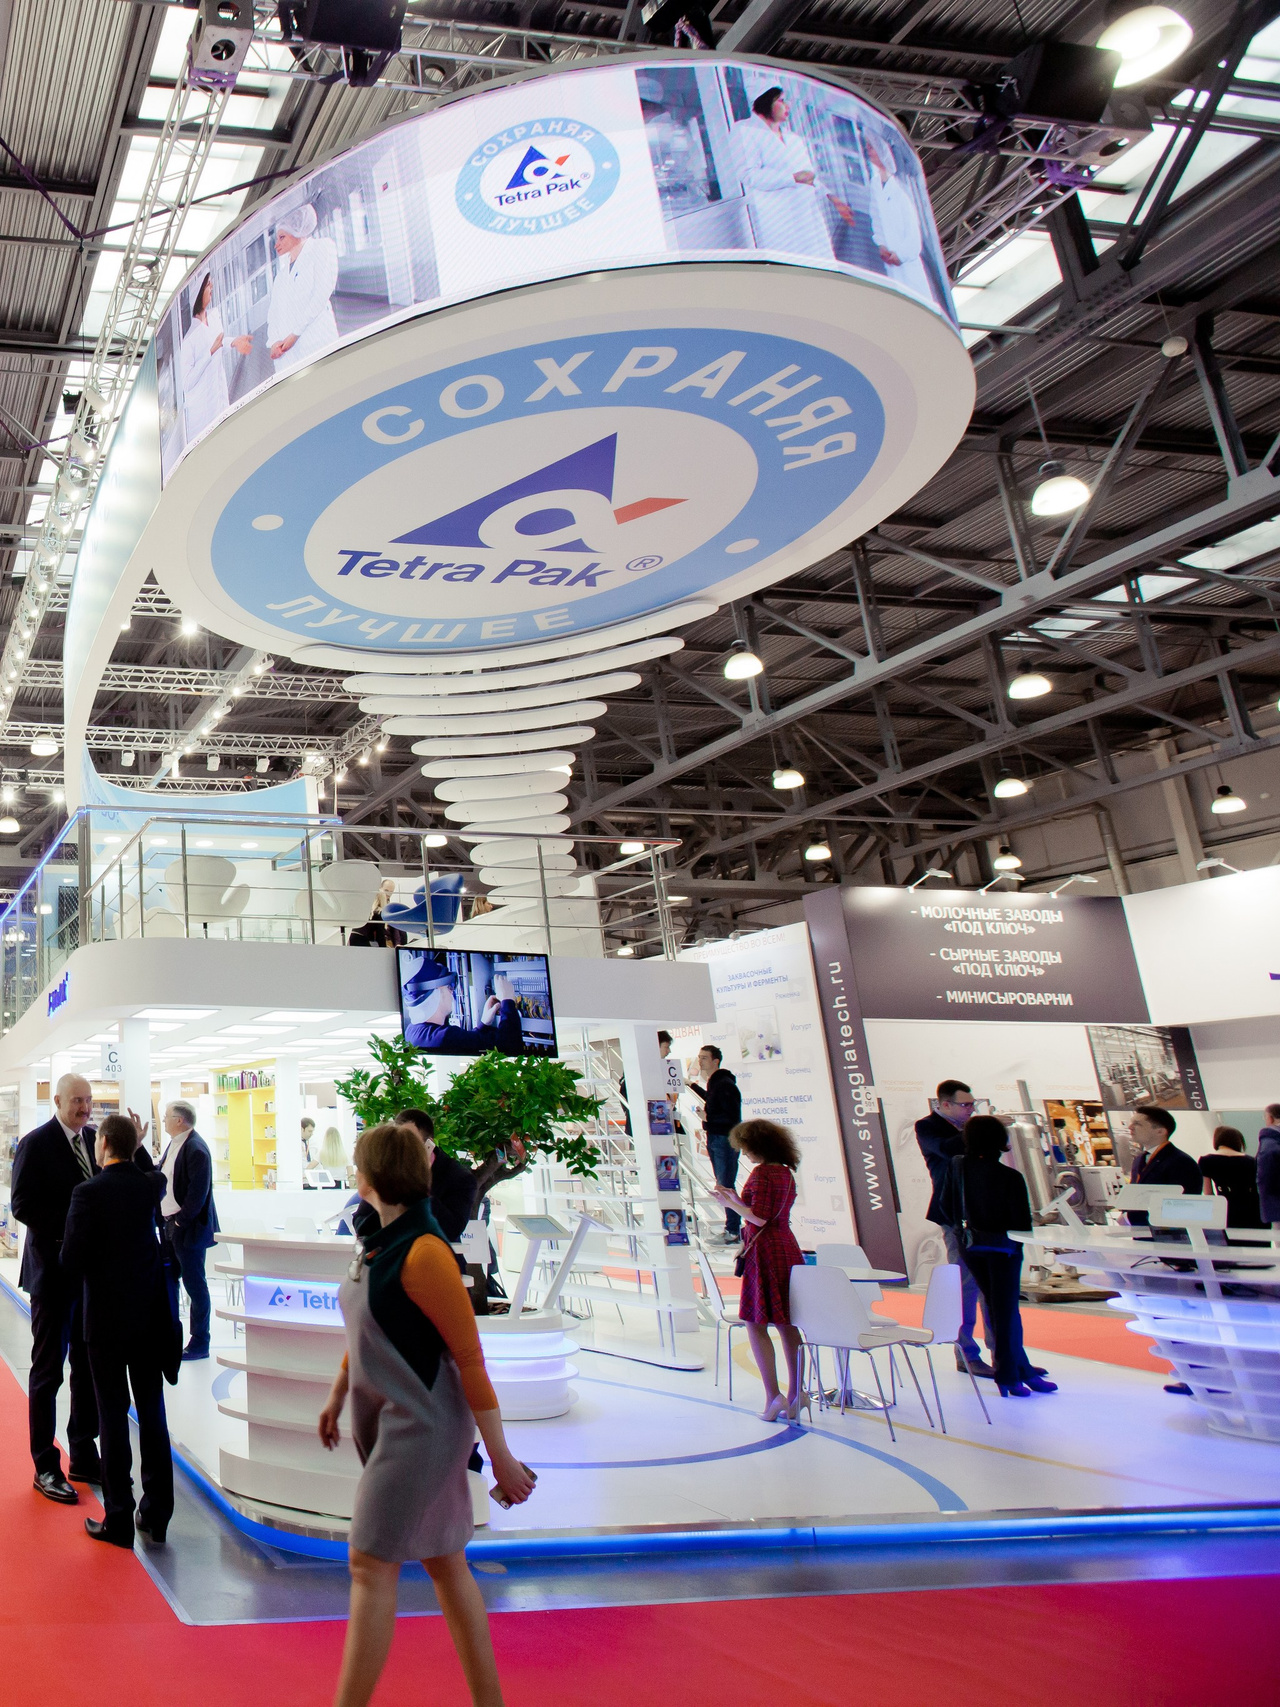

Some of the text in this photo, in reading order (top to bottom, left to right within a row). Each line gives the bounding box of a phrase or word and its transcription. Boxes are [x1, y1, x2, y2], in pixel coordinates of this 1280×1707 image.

[471, 120, 596, 167] СОХРАНЯЯ
[494, 178, 582, 206] Tetra Pak
[489, 197, 595, 232] ЛУЧШЕЕ
[362, 346, 857, 471] СОХРАНЯЯ
[336, 549, 615, 589] Tetra Pak
[266, 596, 574, 643] ЛУЧШЕЕ
[921, 906, 1064, 924] МОЛОЧНЫЕ ЗАВОДЫ
[944, 920, 1036, 936] «ПОД КЛЮЧ»
[693, 940, 748, 960] ПРЕИМУЩЕСТВО
[751, 938, 761, 949] ВО
[939, 948, 1062, 965] СЫРНЫЕ ЗАВОДЫ
[728, 966, 773, 981] ЗАКВАСОЧНЫЕ
[952, 962, 1045, 978] «ПОД КЛЮЧ»
[716, 982, 746, 994] КУЛЬТУРЫ
[753, 975, 789, 987] ФЕРМЕНТЫ
[946, 990, 1074, 1006] МИНИСЫРОВАРНИ
[790, 1022, 812, 1032] Йогурт
[710, 1034, 727, 1042] Творог
[108, 1051, 118, 1064] C
[105, 1064, 122, 1073] 403
[668, 1066, 677, 1078] C
[785, 1067, 811, 1075] Варенец
[667, 1078, 681, 1086] 403
[829, 961, 883, 1211] www.sfoggiatech.ru
[1186, 1068, 1203, 1109] ch.ru
[741, 1094, 813, 1106] КЦИОНАЛЬНЫЕ СМЕСИ
[762, 1107, 788, 1115] ОСНОВЕ
[782, 1117, 804, 1125] БЕЛКА
[814, 1173, 836, 1183] Йогурт
[298, 1289, 339, 1310] Tetr
